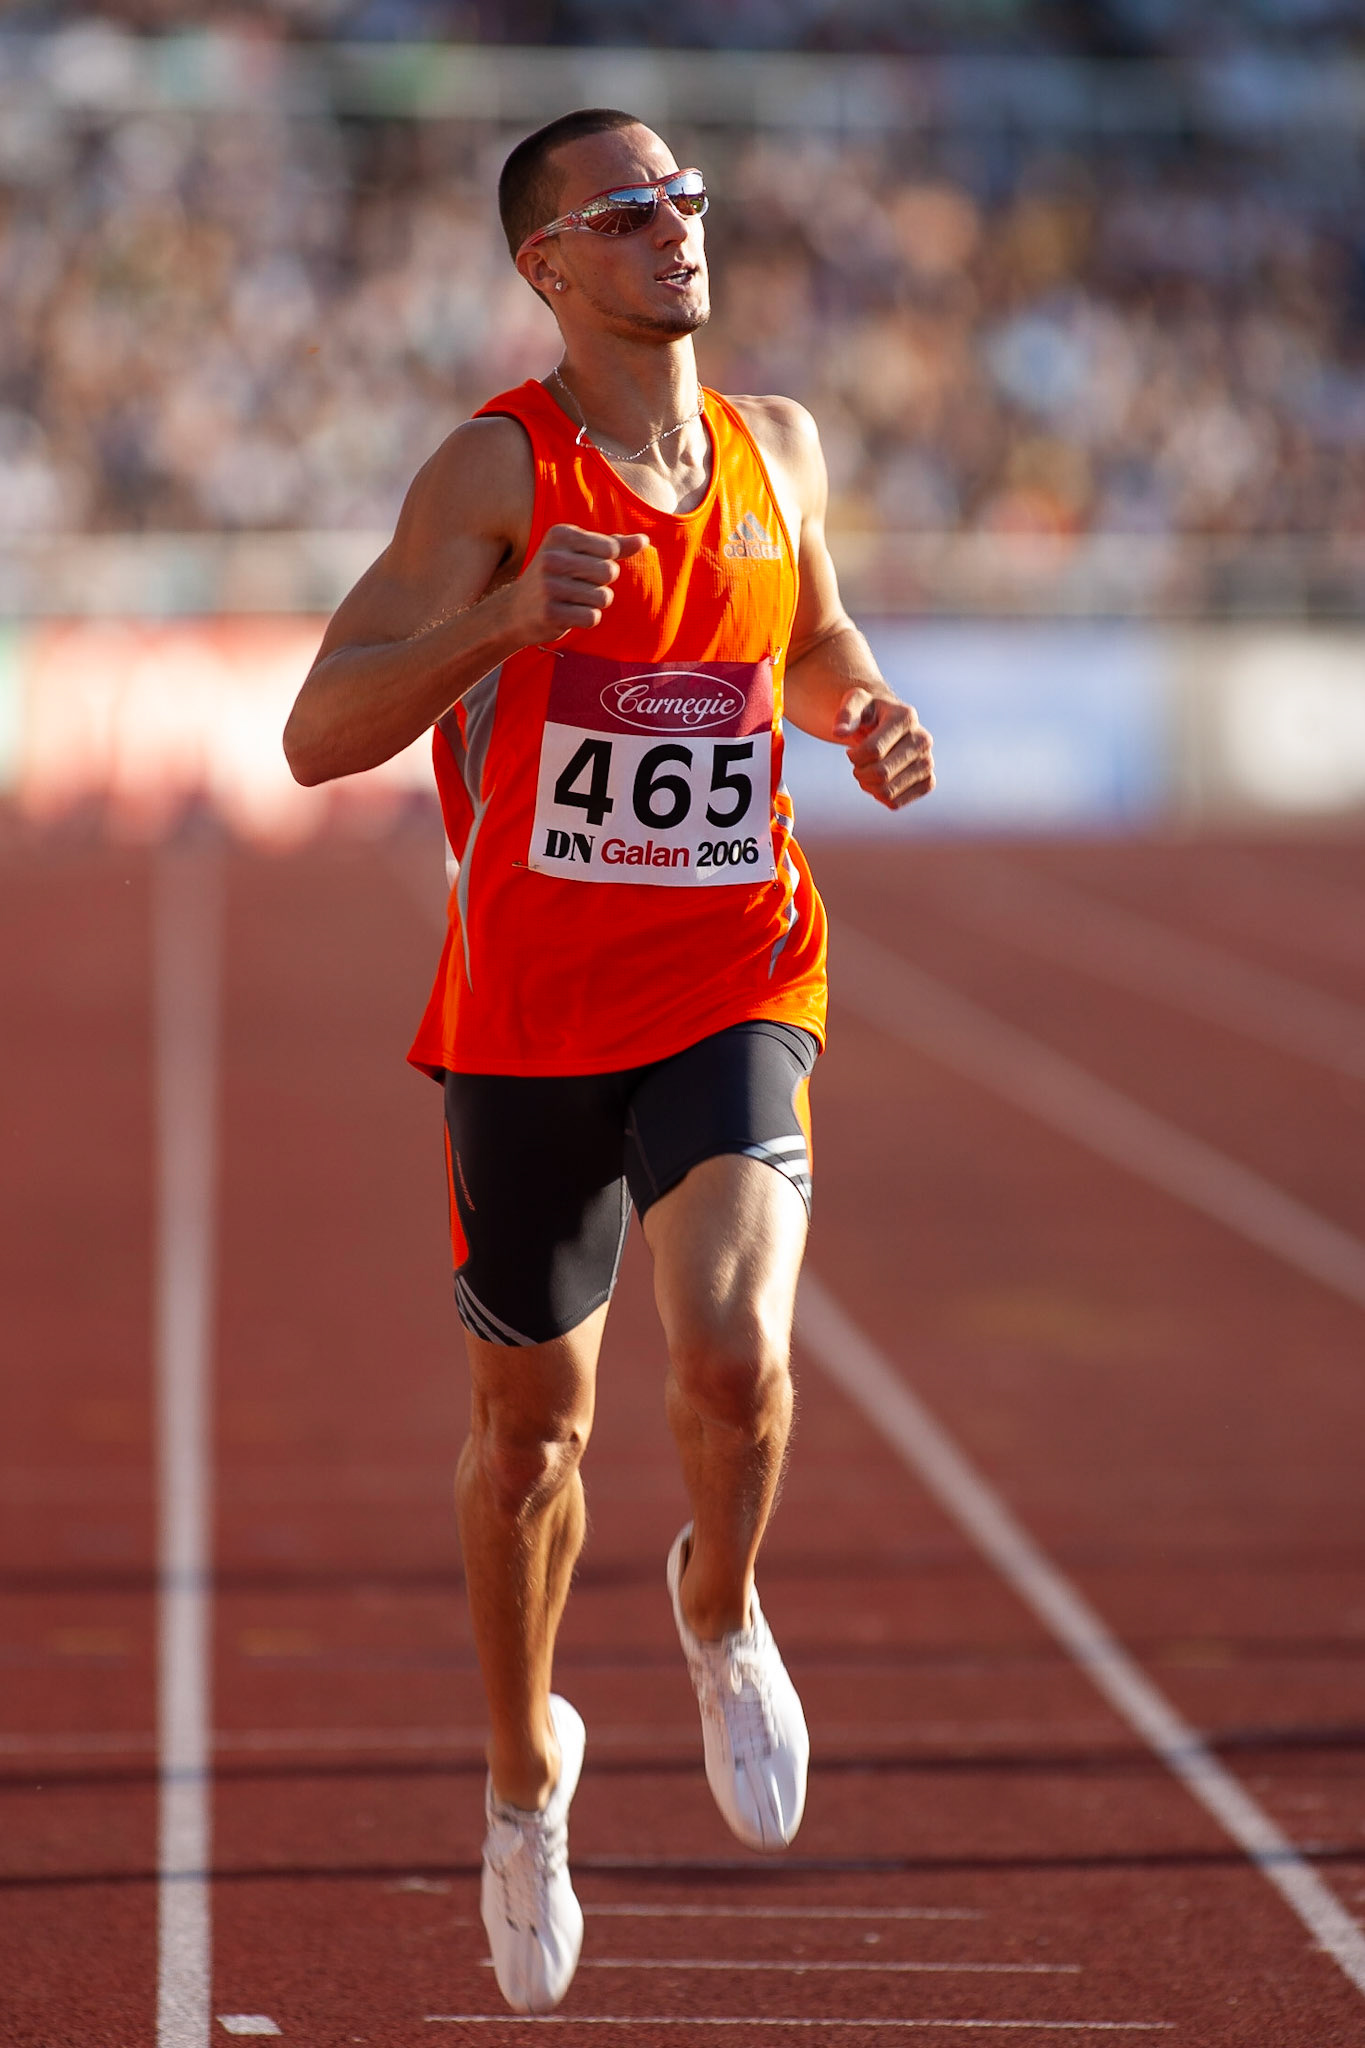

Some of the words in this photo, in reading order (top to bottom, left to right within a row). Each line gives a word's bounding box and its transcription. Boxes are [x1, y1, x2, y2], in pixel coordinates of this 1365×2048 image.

[723, 541, 782, 560] adidas
[614, 684, 736, 725] Carnegie
[554, 738, 754, 829] 465
[543, 828, 596, 864] DN
[601, 838, 689, 867] Galan
[696, 837, 759, 867] 2006
